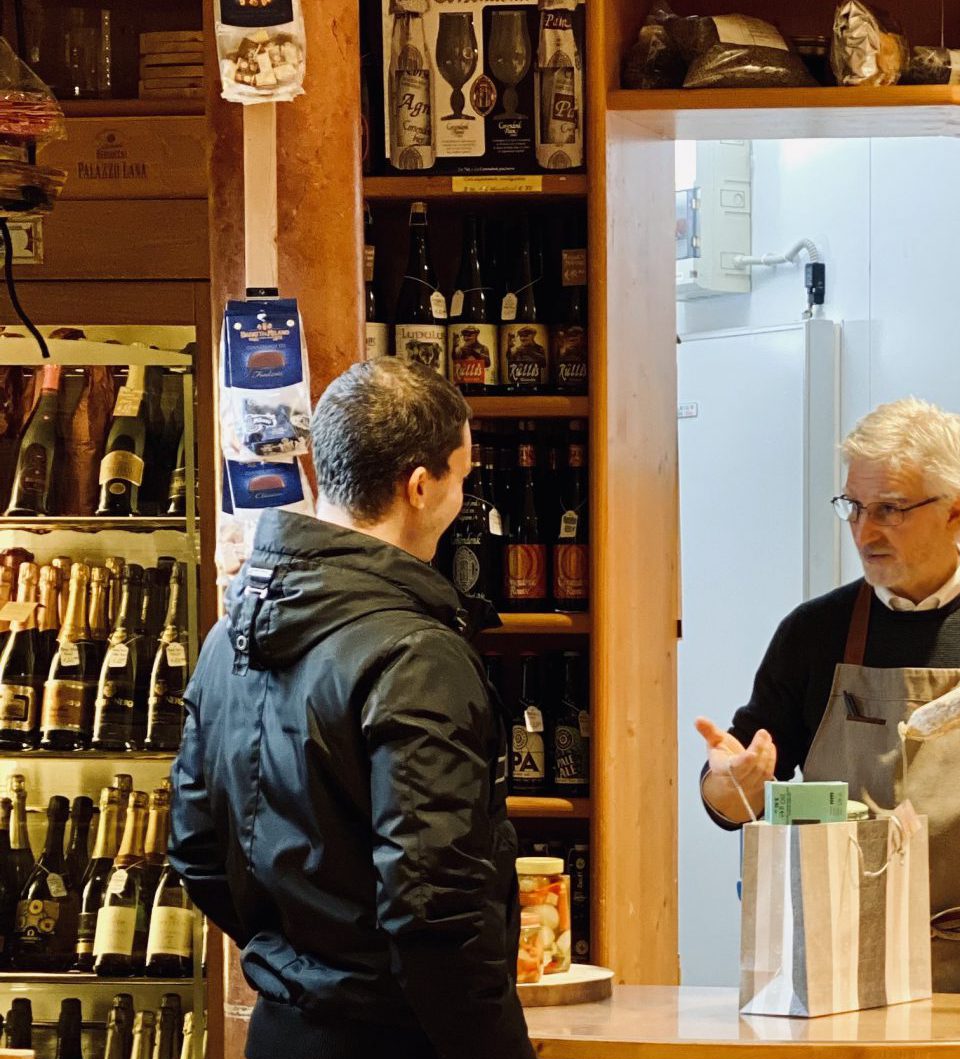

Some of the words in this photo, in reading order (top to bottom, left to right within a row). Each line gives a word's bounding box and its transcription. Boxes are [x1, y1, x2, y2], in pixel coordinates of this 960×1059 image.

[512, 751, 540, 773] PA
[556, 755, 575, 769] PALE
[559, 764, 579, 779] ALE
